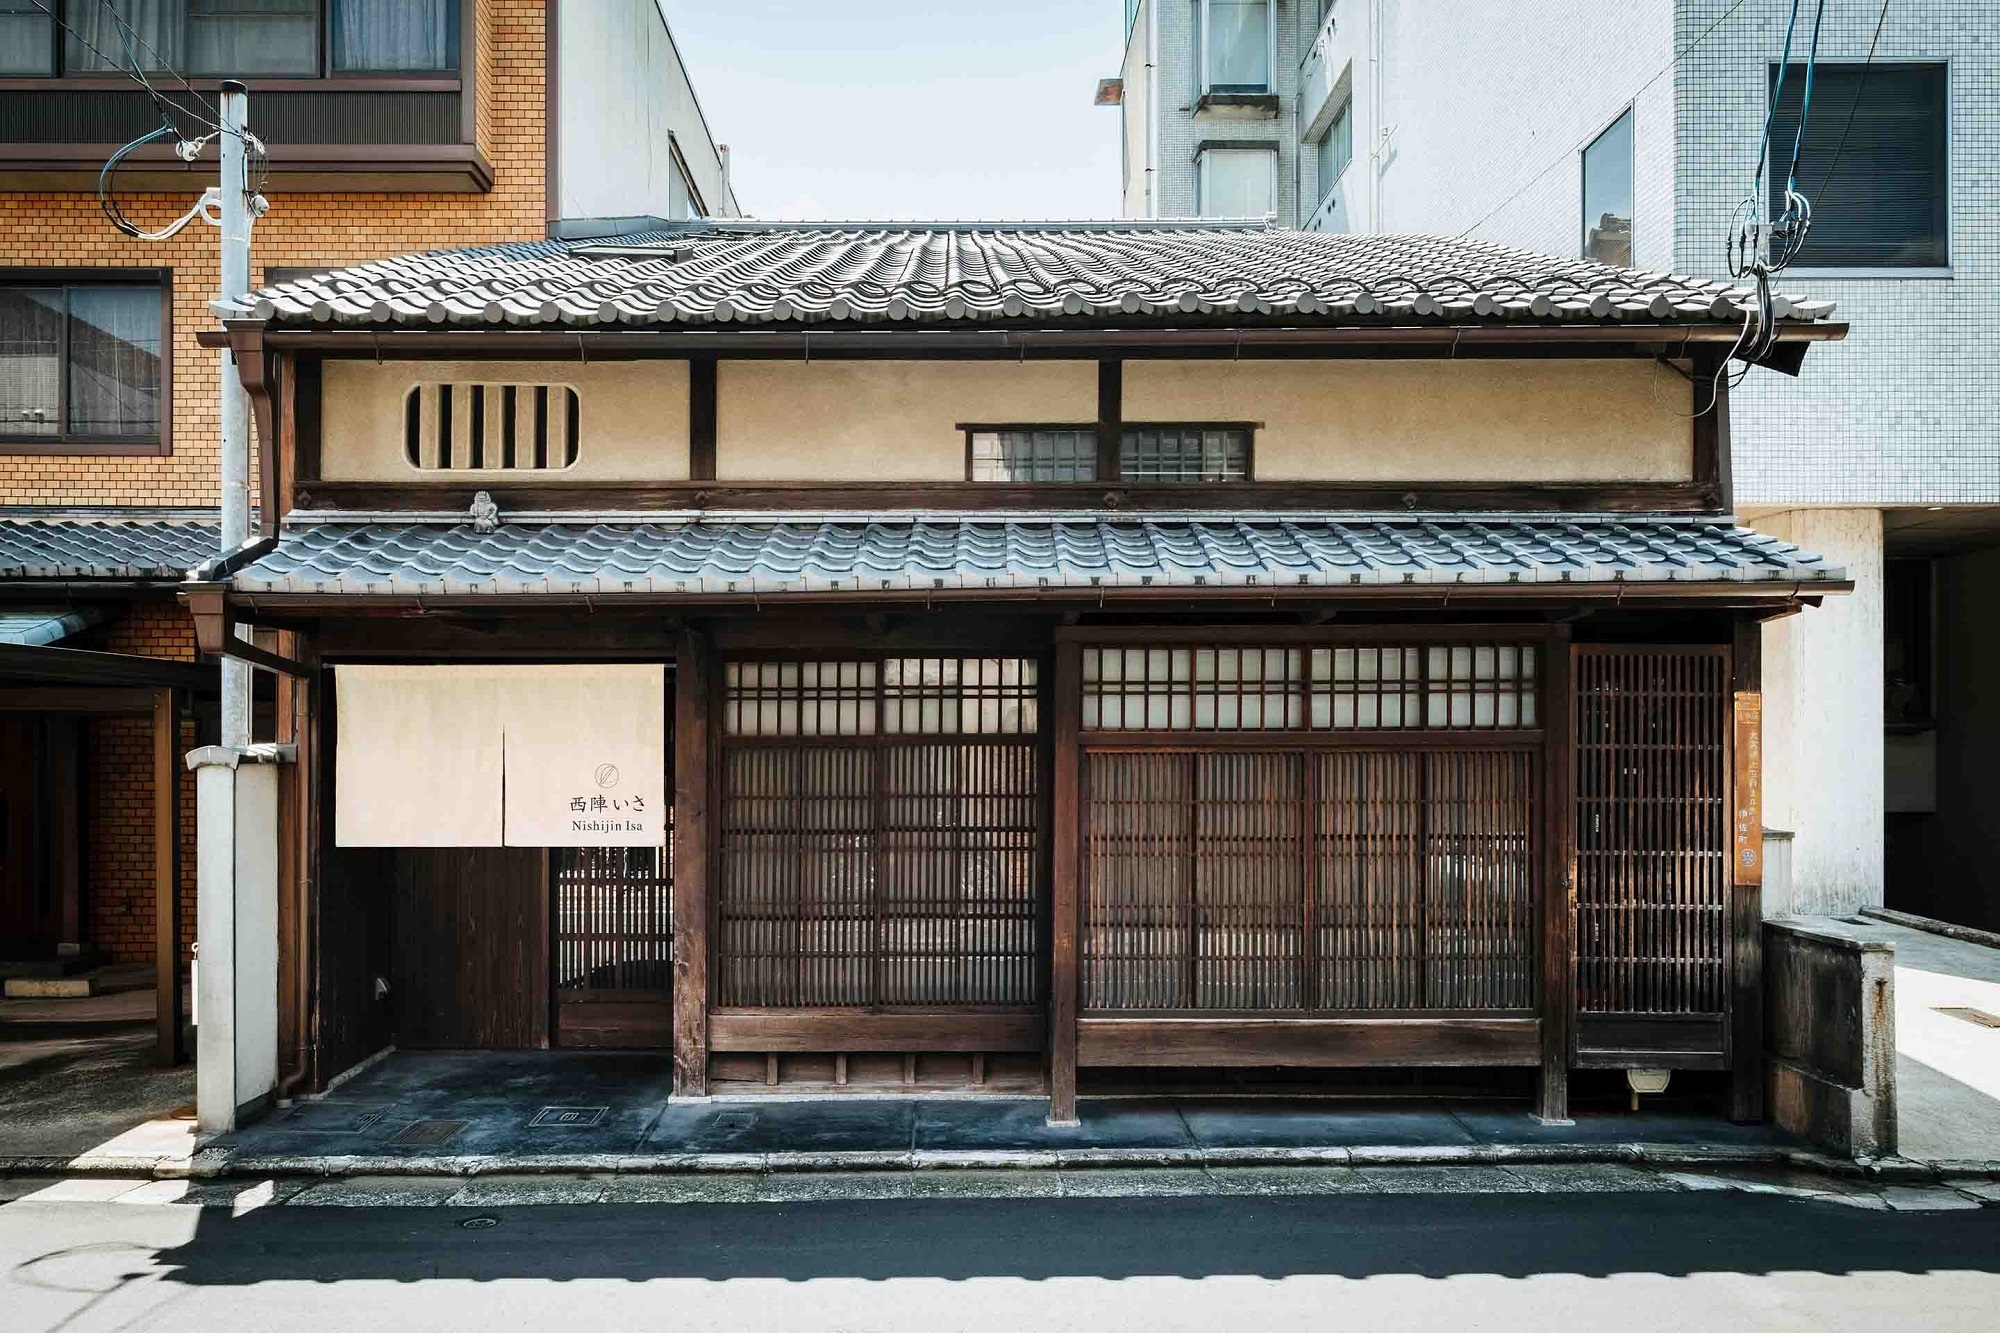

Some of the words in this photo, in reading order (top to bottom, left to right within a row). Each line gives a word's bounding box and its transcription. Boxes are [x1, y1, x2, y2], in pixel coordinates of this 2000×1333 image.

[570, 794, 645, 814] 西陣いさ
[572, 820, 622, 833] Nishijin
[626, 820, 643, 831] Isa
